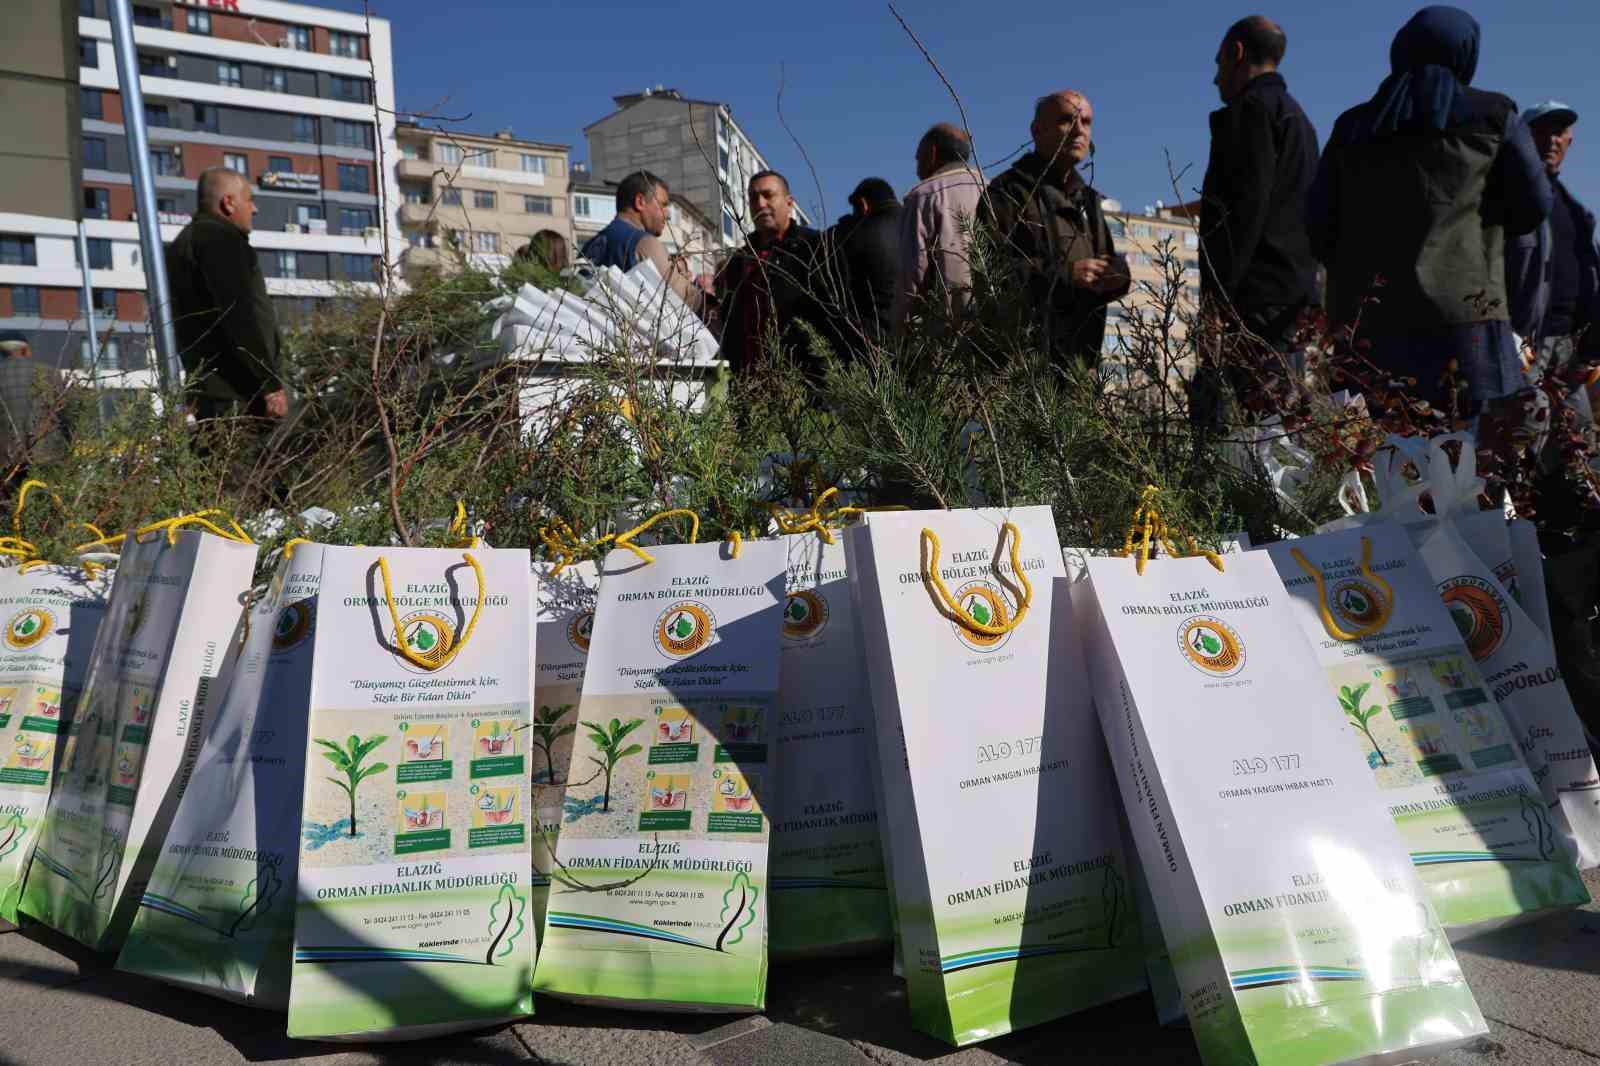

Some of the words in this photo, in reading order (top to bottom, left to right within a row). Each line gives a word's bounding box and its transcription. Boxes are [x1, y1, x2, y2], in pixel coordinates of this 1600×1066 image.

[671, 575, 712, 586] ELAZIĞ
[899, 569, 938, 584] ORMA
[942, 566, 977, 580] BÖLGE
[407, 581, 449, 594] ELAZIĞ
[617, 591, 655, 602] ORMAN
[657, 588, 694, 600] BÖLGE
[1169, 587, 1209, 602] ELAZIĞ
[1121, 604, 1161, 616] ORMAN
[1163, 602, 1200, 616] BÖLGE
[372, 692, 400, 704] Sizde
[400, 692, 415, 703] Bir
[417, 691, 444, 702] Fidan
[976, 741, 1012, 763] ALO
[1232, 756, 1268, 775] ALO
[1271, 753, 1300, 771] 177
[959, 775, 990, 790] ORMAN
[1219, 788, 1251, 800] ORMAN
[397, 862, 442, 877] ELAZIĞ
[568, 857, 611, 869] ORMAN
[614, 856, 671, 870] FİDANLIK
[673, 858, 752, 873] MÜDÜRLÜĞÜ
[317, 887, 367, 900] ORMAN
[371, 880, 432, 896] FİDANLIK
[435, 872, 518, 889] MÜDÜRLÜĞÜ
[947, 884, 992, 906] ORMAN
[1224, 896, 1274, 918] ORMAN
